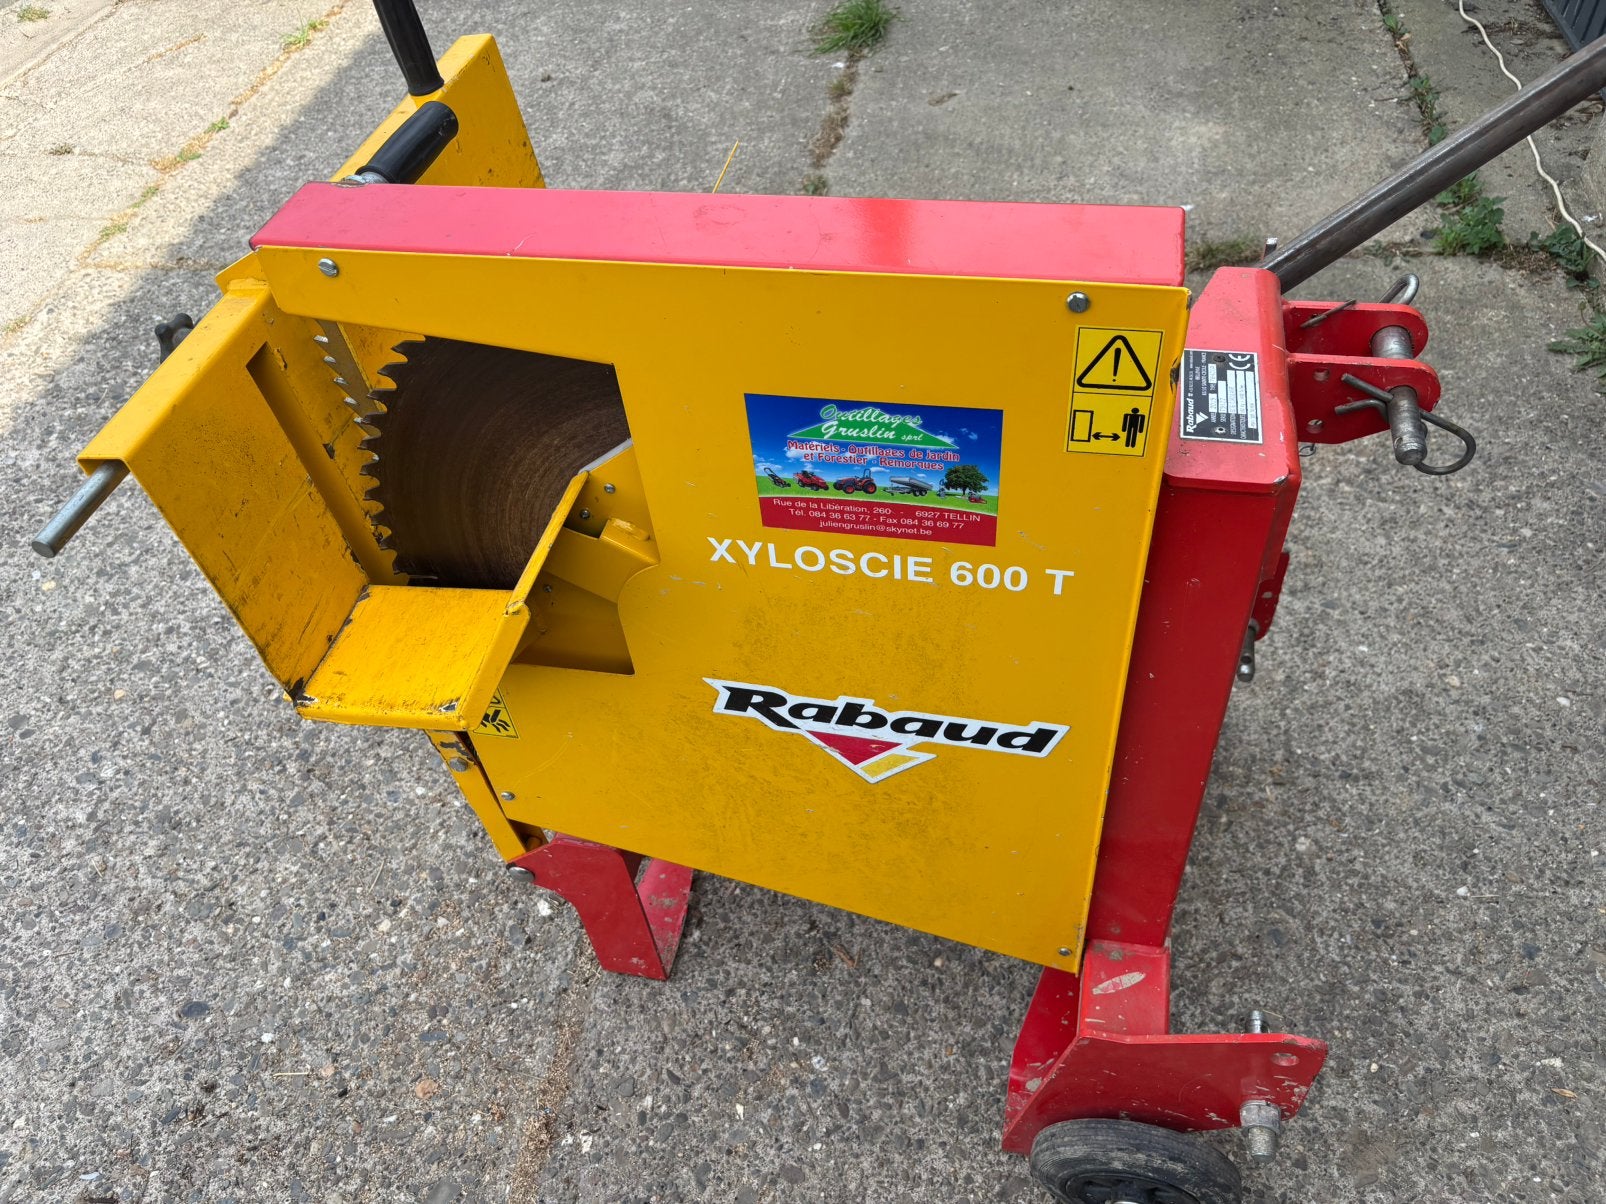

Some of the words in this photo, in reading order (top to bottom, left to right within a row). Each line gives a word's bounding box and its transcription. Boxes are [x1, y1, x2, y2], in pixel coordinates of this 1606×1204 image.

[820, 404, 922, 428] Outillages
[1186, 397, 1197, 432] Rabaud
[821, 420, 896, 439] Gruslin
[901, 433, 923, 441] sprl
[787, 440, 839, 453] Matériels
[848, 444, 905, 458] Outillages
[909, 449, 923, 459] de
[803, 452, 814, 461] et
[817, 453, 867, 465] Forestier
[879, 458, 944, 470] Remorques
[773, 498, 792, 507] Rue
[794, 500, 807, 508] de
[809, 501, 818, 509] la
[820, 502, 870, 514] Libération,
[873, 507, 891, 515] 260
[915, 510, 940, 519] 6927
[943, 512, 981, 522] TELLIN
[789, 508, 806, 517] Tél.
[808, 510, 826, 518] 084
[829, 511, 841, 519] 36
[844, 513, 856, 521] 63
[858, 514, 871, 522] 77
[880, 516, 898, 524] Fax
[900, 518, 918, 526] 084
[921, 519, 934, 527] 36
[936, 520, 949, 528] 69
[952, 521, 965, 529] 77
[819, 520, 932, 536] juliengruslin@skynet.be
[706, 537, 934, 583] XYLOSCIE
[950, 561, 1029, 592] 600
[1045, 568, 1075, 595] T
[722, 685, 1059, 753] Rabaud
